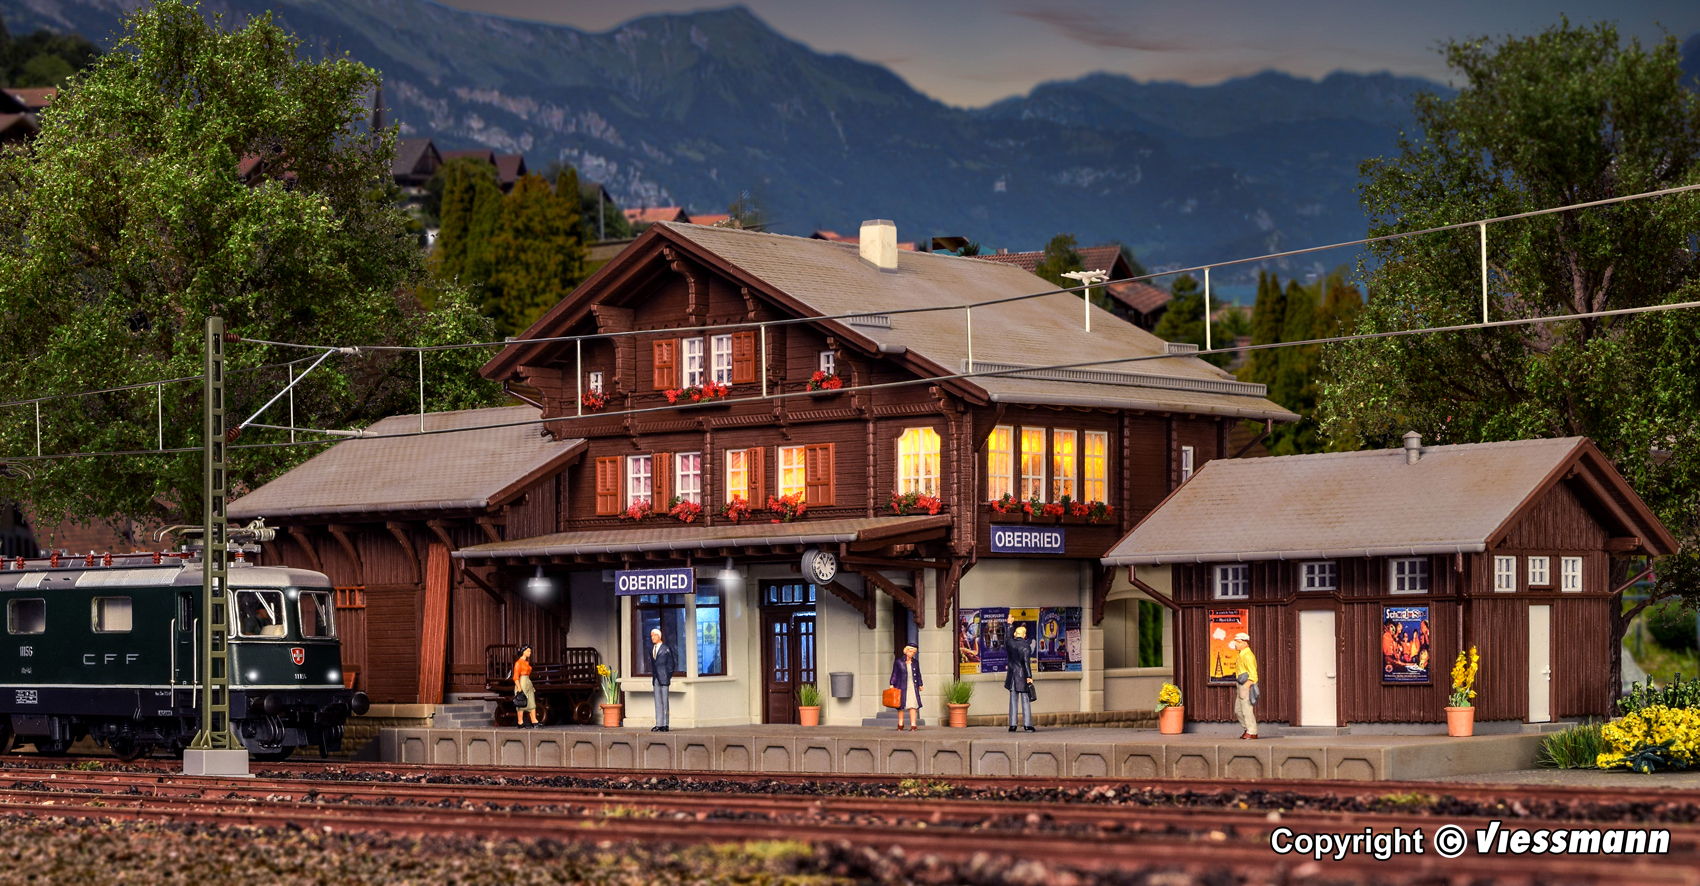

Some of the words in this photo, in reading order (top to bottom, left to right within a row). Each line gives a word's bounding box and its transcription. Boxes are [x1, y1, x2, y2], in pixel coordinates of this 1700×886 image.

[995, 531, 1061, 548] OBERRIED
[618, 574, 688, 591] OBERRIED
[83, 653, 140, 665] CFF
